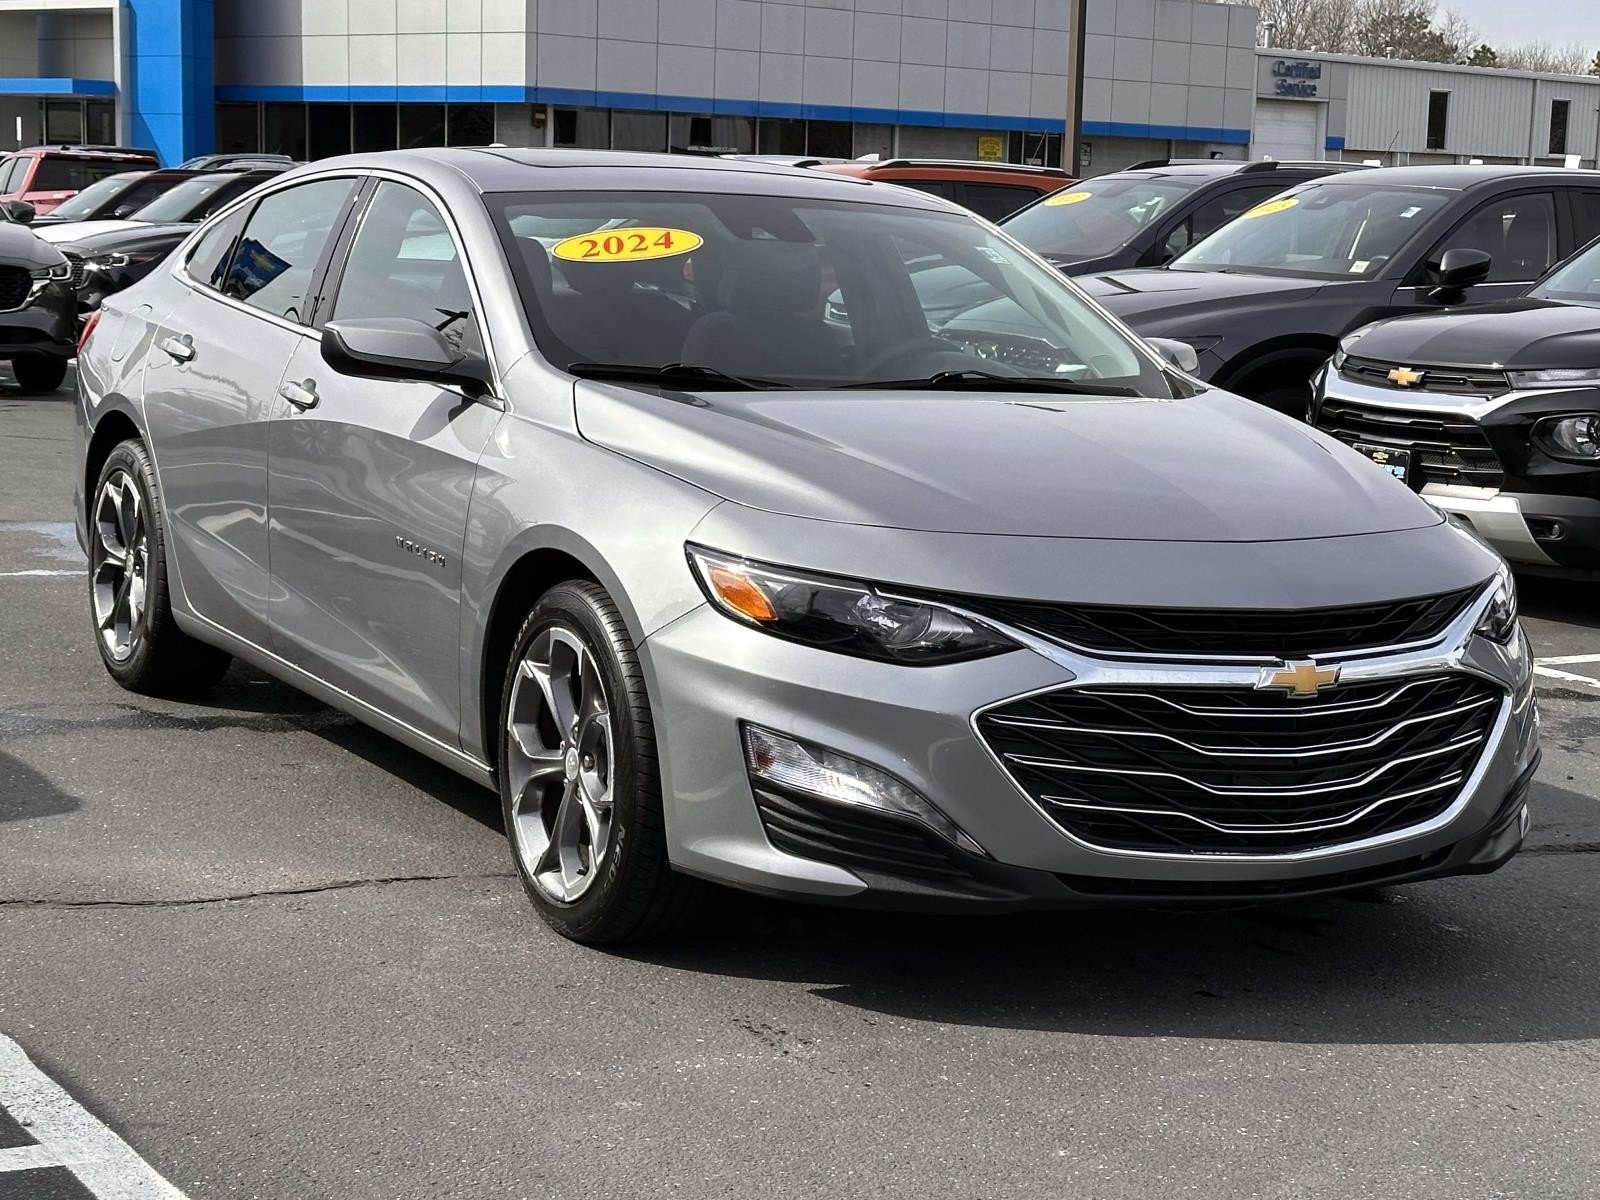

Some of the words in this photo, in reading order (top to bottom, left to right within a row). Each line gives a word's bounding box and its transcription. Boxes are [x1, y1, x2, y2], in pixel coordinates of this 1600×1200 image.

[1273, 60, 1321, 79] Certified
[1277, 78, 1317, 97] Service
[579, 231, 674, 258] 2024
[395, 535, 446, 568] MALIBU
